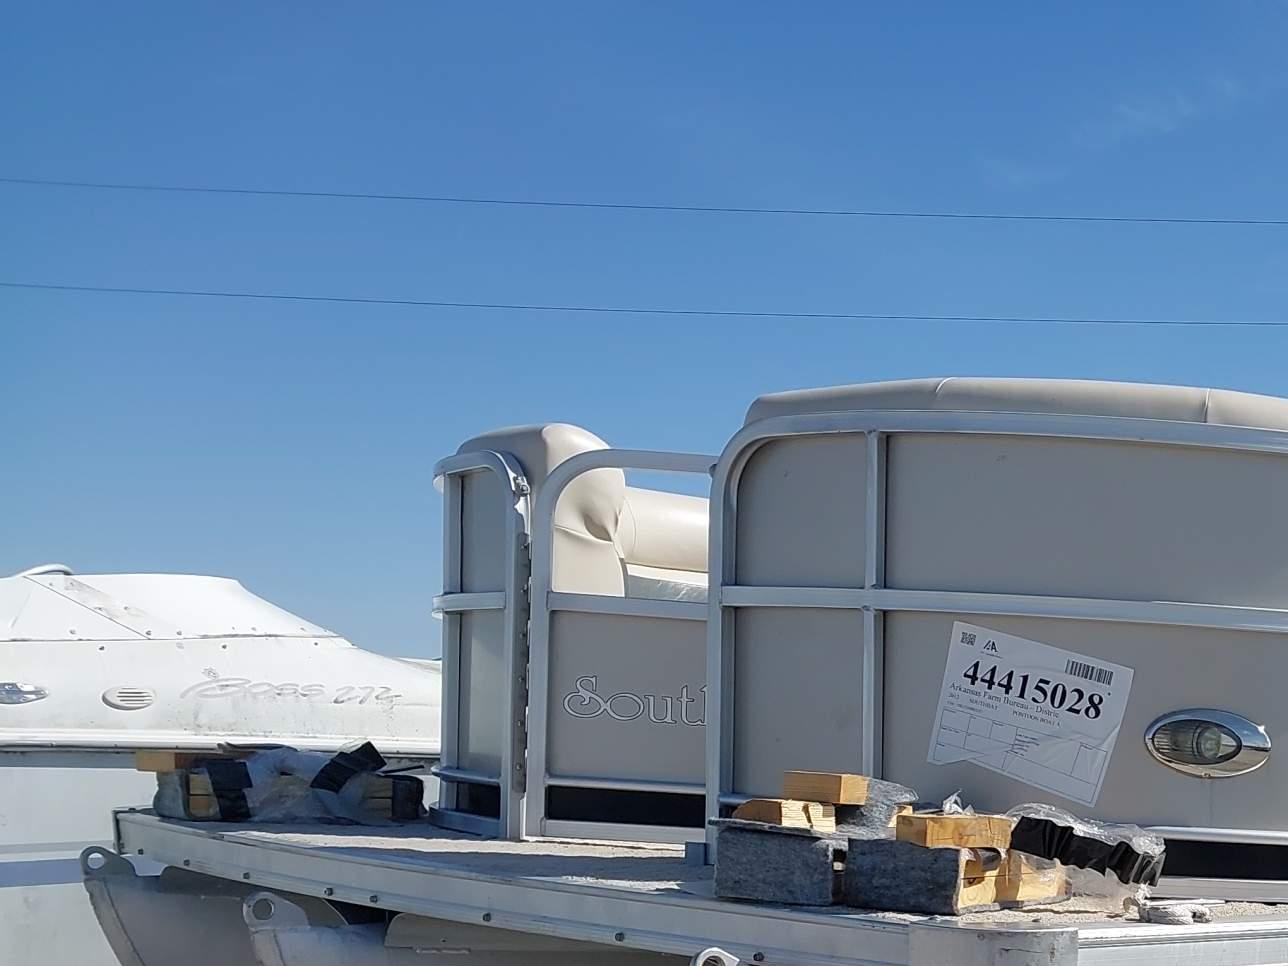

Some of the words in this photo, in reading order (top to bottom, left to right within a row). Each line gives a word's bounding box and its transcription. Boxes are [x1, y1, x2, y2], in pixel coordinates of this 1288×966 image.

[950, 681, 982, 698] Arkansas
[982, 690, 1002, 703] Farm
[1003, 696, 1030, 711] Bureau
[963, 660, 1104, 720] 44415028
